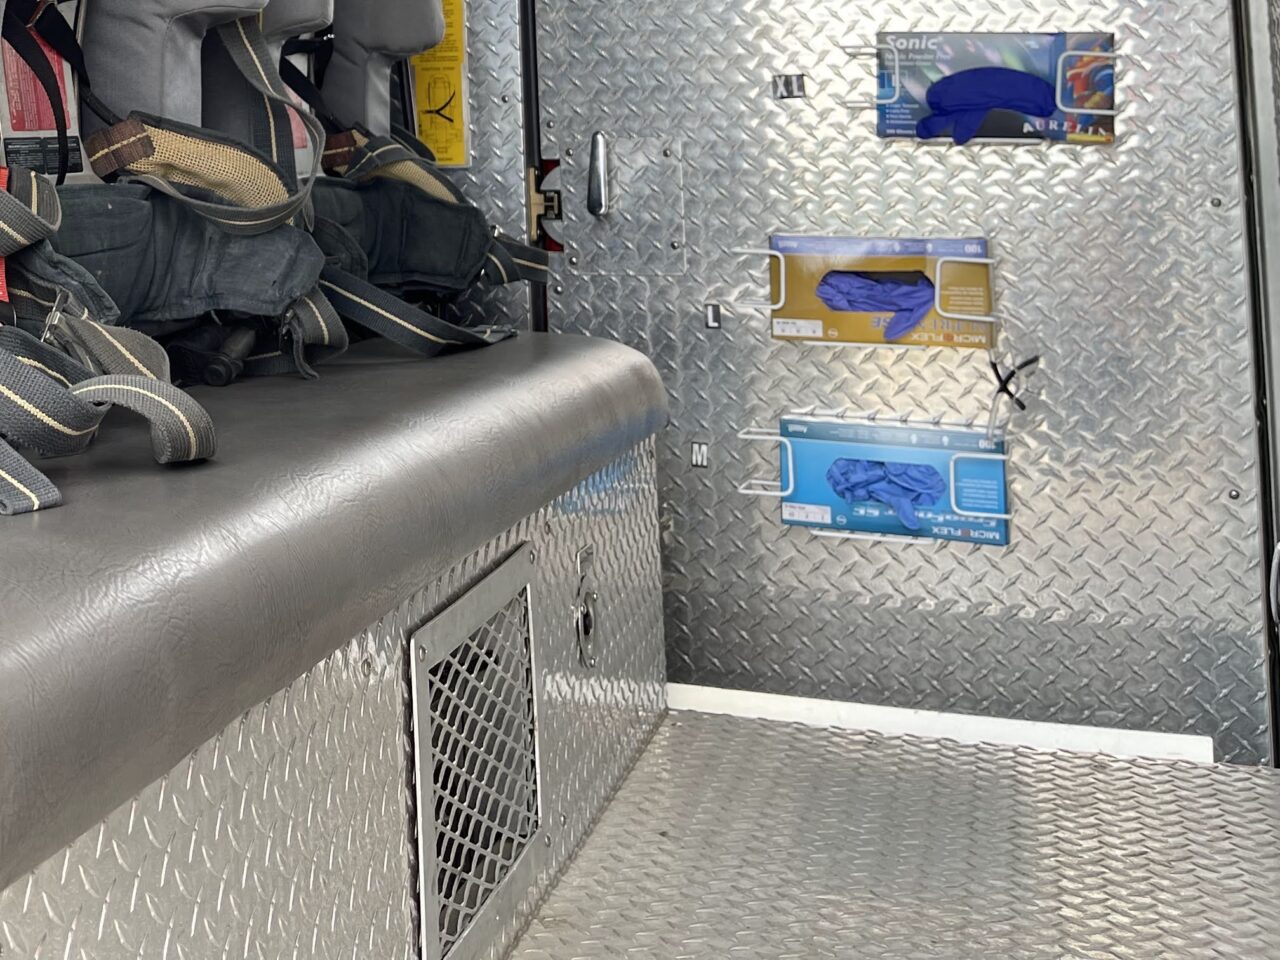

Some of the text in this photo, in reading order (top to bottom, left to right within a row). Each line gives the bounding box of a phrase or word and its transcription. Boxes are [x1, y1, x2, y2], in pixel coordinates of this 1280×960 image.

[775, 75, 804, 97] XL
[707, 305, 719, 328] L
[911, 332, 987, 344] MICROFLEX
[692, 442, 708, 466] M
[931, 526, 1000, 540] MICROFLEX
